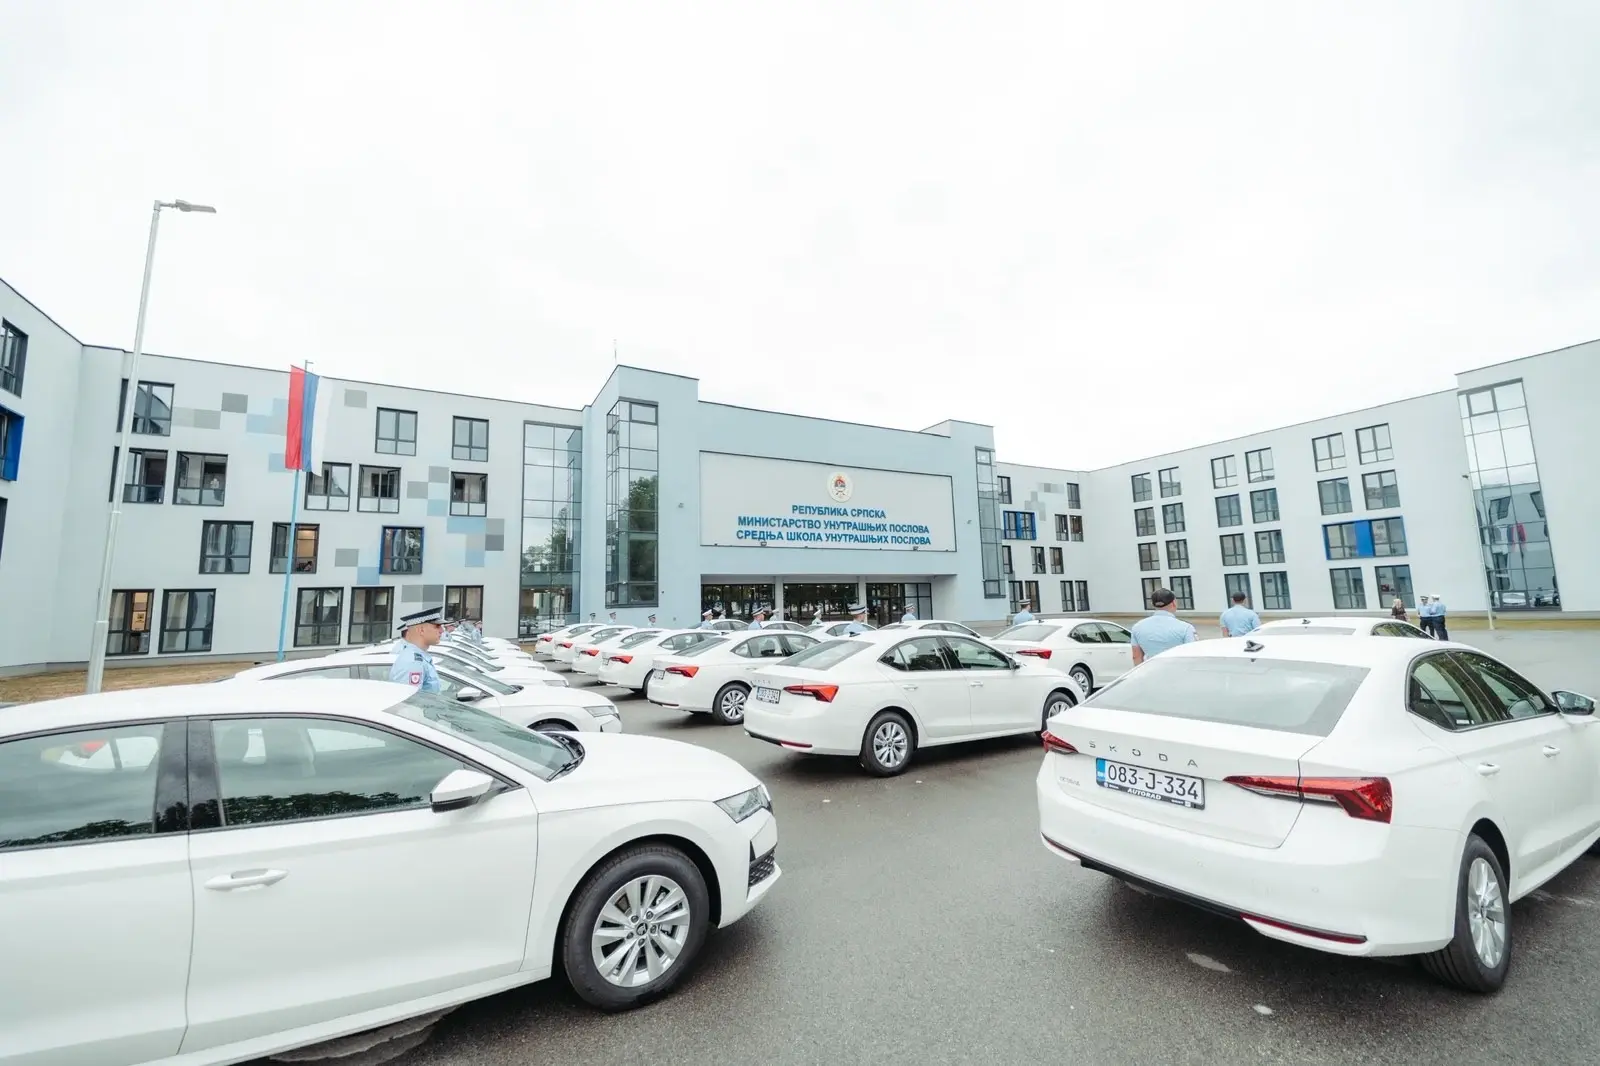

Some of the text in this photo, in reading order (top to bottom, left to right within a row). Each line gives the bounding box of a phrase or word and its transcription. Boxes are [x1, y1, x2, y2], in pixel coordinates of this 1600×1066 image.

[792, 505, 886, 518] РЕПУБЛИКА СРПСКА
[738, 516, 930, 534] МИНИСТАРСТВО УНУТРАШЊИХ ПОСЛОВА
[736, 530, 931, 545] СРЕДЊА ШКОЛА УНУТРАШЊИХ ПОСЛОВА
[1107, 764, 1199, 800] 083-J-334
[1127, 787, 1162, 801] AUTORAD
